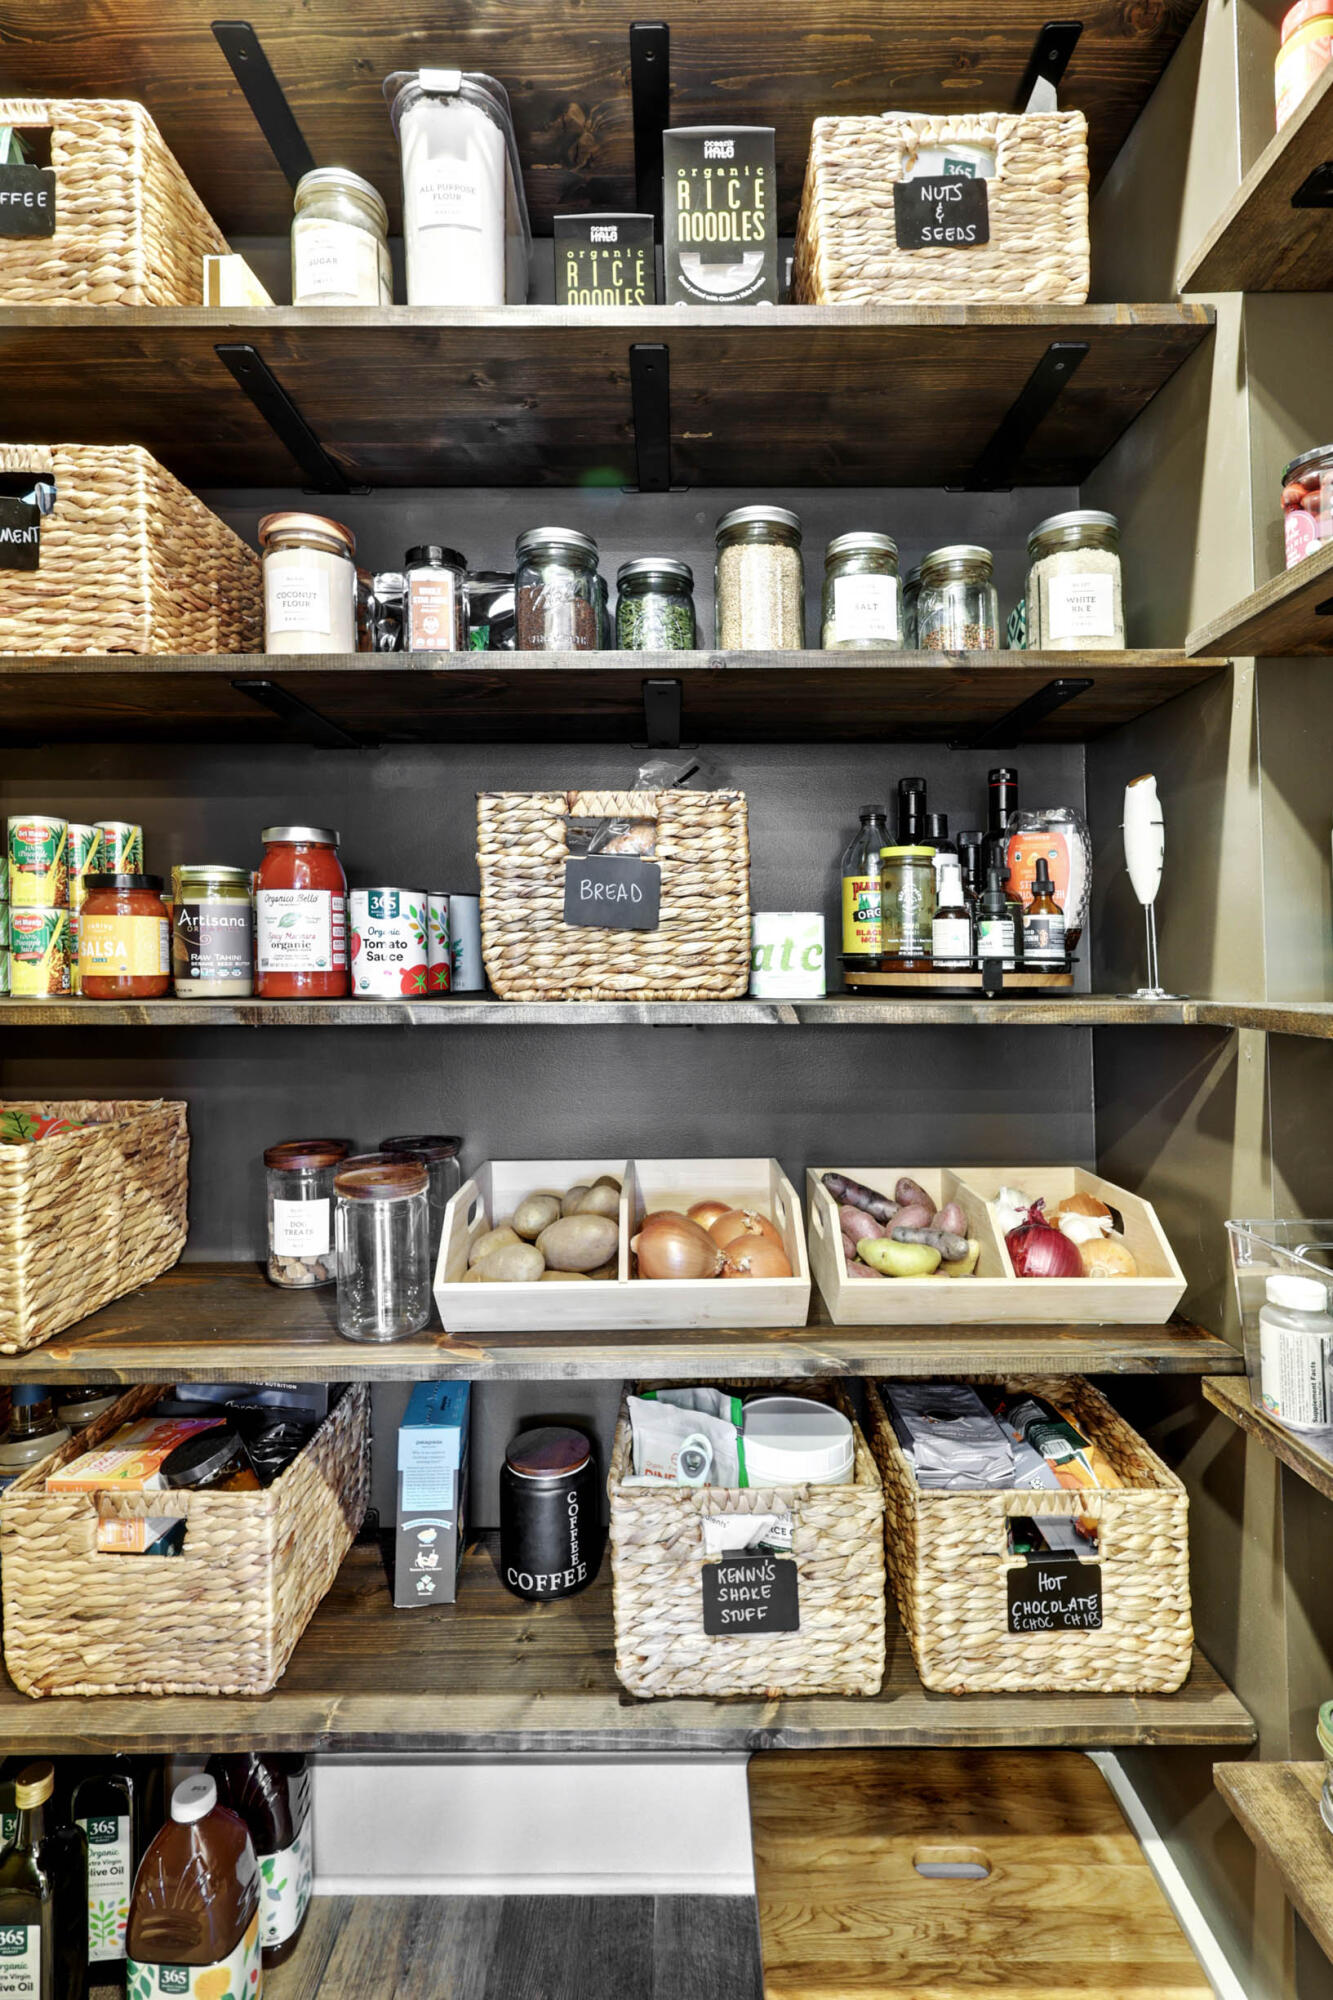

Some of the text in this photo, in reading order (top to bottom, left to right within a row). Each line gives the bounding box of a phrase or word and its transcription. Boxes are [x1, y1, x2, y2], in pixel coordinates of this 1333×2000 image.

[677, 165, 765, 179] organic
[677, 178, 765, 210] RICE
[921, 182, 963, 202] NUTS
[935, 202, 945, 224] &
[677, 210, 766, 242] NOODLES
[920, 224, 977, 241] SEEDS
[566, 248, 645, 260] organic
[566, 260, 645, 288] RICE
[276, 591, 317, 600] COCONUT
[282, 600, 310, 608] FLOUR
[1066, 596, 1097, 604] WHITE
[580, 879, 643, 903] BREAD
[370, 896, 397, 910] 365
[178, 908, 246, 926] Artisana
[81, 941, 127, 957] SALSA
[271, 941, 312, 950] organic
[363, 939, 408, 950] Tomato
[190, 953, 242, 961] RAW TAHINI
[366, 951, 404, 962] Sauce
[1311, 1382, 1319, 1424] Supplement
[567, 1491, 579, 1566] COFFEE
[507, 1562, 587, 1592] COFFEE
[717, 1559, 776, 1585] KENNY'S
[1038, 1571, 1067, 1592] HOT
[717, 1584, 772, 1602] SHAKE
[1011, 1593, 1098, 1617] CHOCOLATE
[721, 1606, 769, 1624] STUFF
[90, 1821, 116, 1835] 365
[109, 1866, 124, 1876] Oil
[0, 1929, 25, 1946] 365
[161, 1969, 187, 1985] 365
[18, 1981, 34, 1992] Oil
